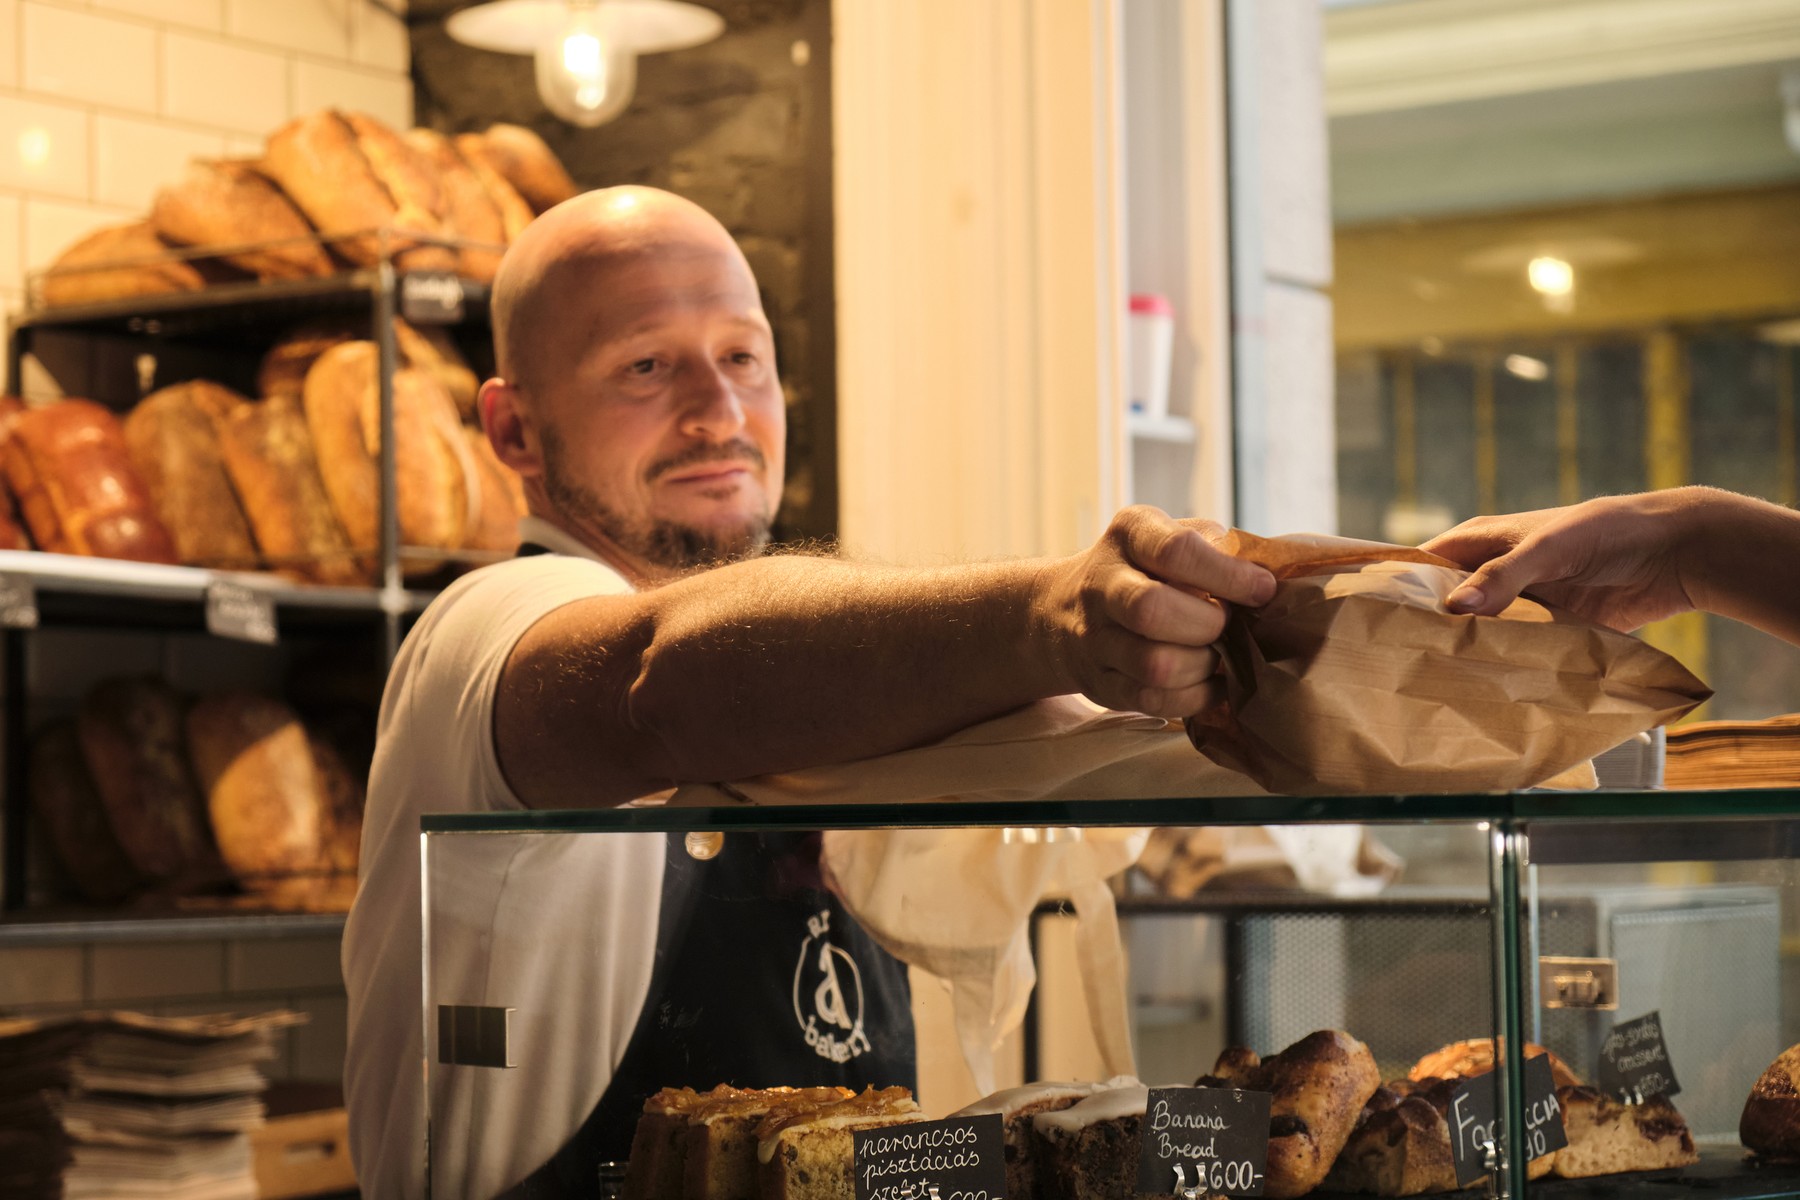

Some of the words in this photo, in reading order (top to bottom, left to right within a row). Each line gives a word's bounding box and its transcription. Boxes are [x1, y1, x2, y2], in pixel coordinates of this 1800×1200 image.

[1151, 1100, 1231, 1130] Banana
[859, 1125, 978, 1158] narancsos
[1157, 1132, 1219, 1159] Bread
[862, 1147, 980, 1190] pisztáciás
